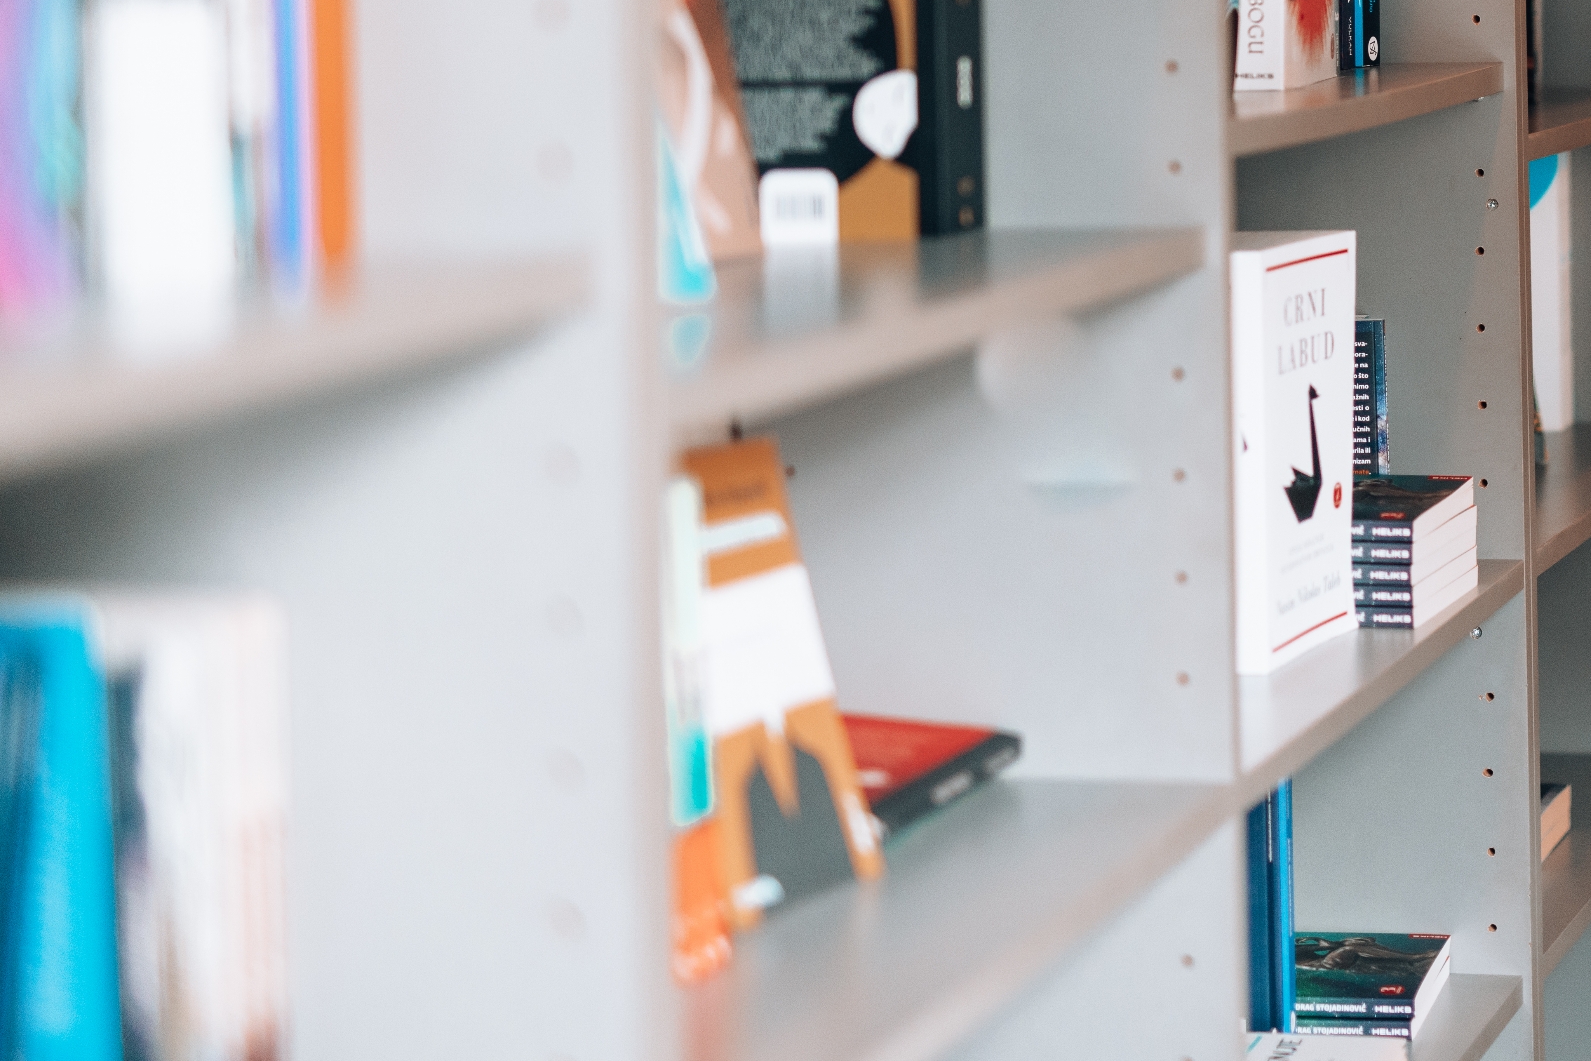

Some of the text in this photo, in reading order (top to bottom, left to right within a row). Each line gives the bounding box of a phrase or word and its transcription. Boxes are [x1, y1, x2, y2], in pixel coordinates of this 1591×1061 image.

[1284, 288, 1326, 327] CRNI
[1278, 330, 1335, 375] LABUD
[1371, 527, 1411, 537] HELIKS
[1371, 549, 1410, 559] HELIKS
[1369, 571, 1409, 581] HELIKS
[1371, 592, 1411, 602] HELIKS
[1372, 614, 1412, 624] HELIKS
[1315, 1002, 1367, 1014] STOJADINOVIĆ
[1374, 1005, 1412, 1014] HELIKS
[1371, 1027, 1409, 1036] HELIKS
